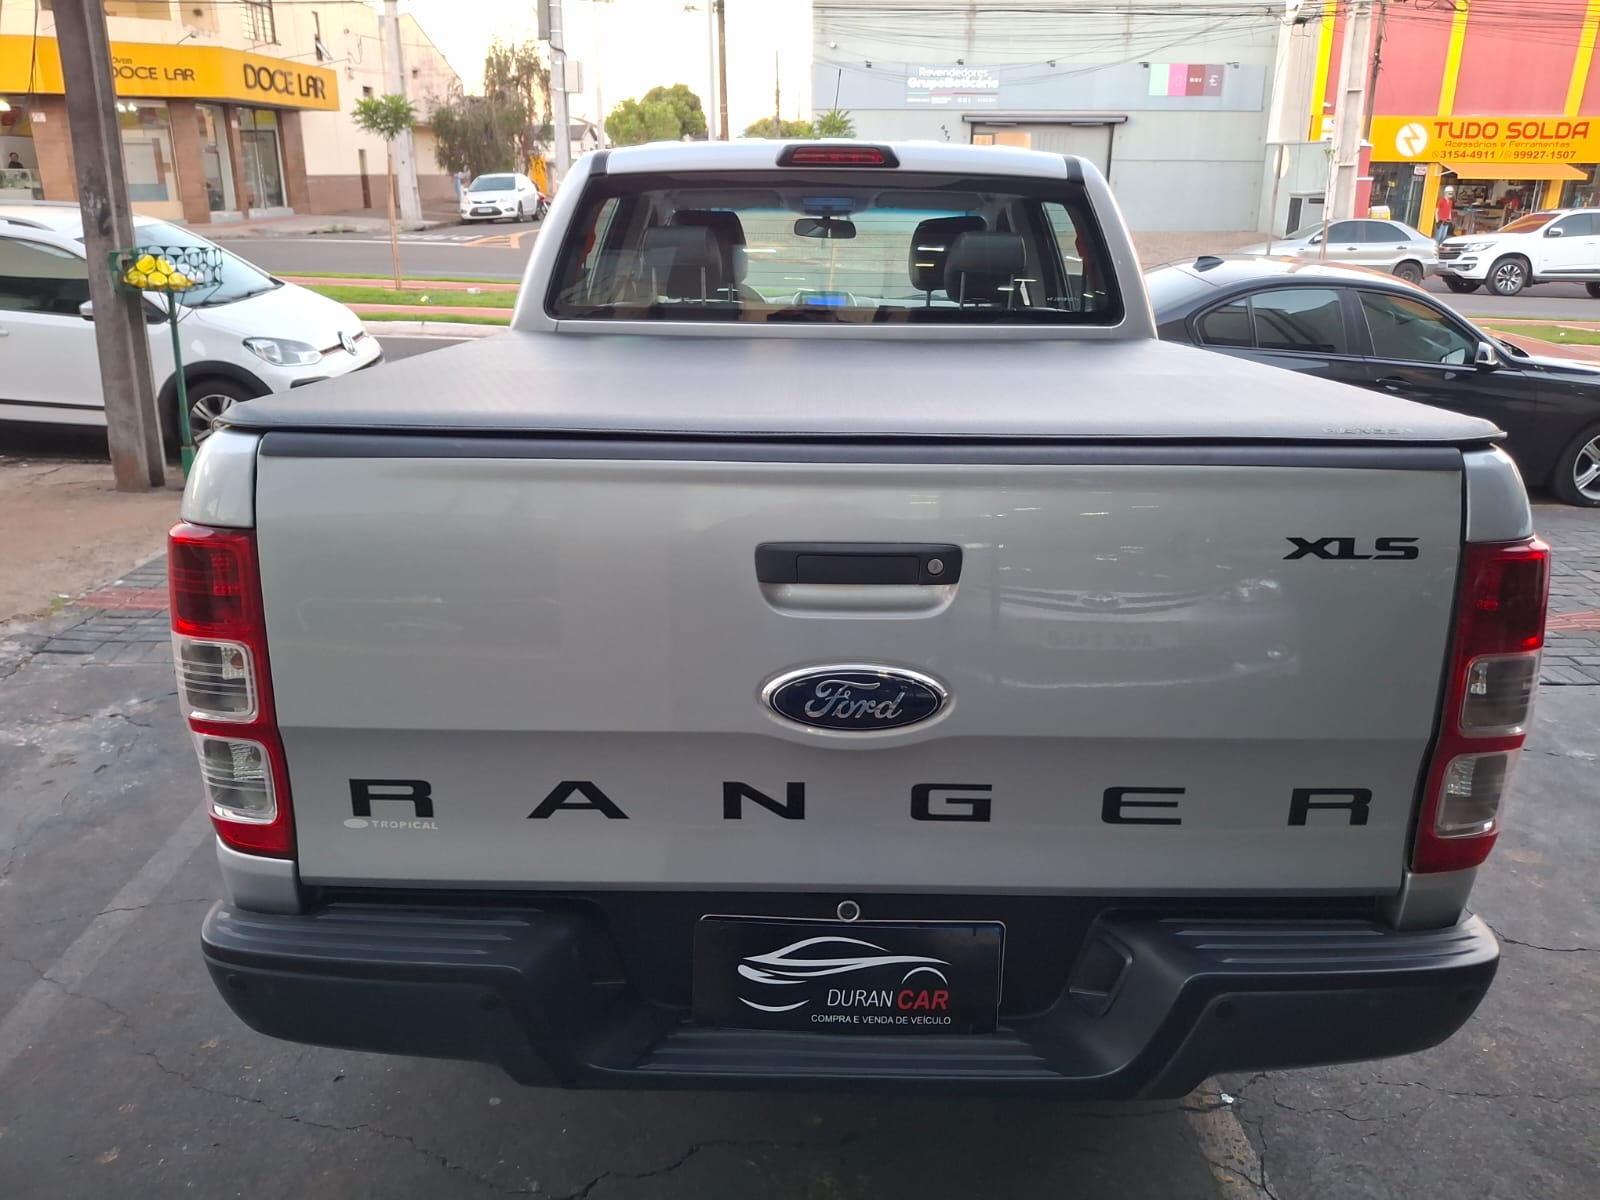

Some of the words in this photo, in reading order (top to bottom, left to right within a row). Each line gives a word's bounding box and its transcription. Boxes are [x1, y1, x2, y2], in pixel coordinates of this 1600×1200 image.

[164, 67, 196, 82] LAR
[243, 63, 295, 96] DOCE
[297, 73, 326, 100] LAR
[1434, 122, 1499, 140] TUDO
[1505, 122, 1590, 140] SOLDA
[1445, 140, 1497, 148] Acessórios
[1508, 141, 1570, 149] Ferramentas
[1440, 150, 1495, 159] 3154-4911
[1513, 151, 1577, 159] 99927-1507
[1282, 537, 1420, 560] XLS
[804, 679, 906, 720] Ford
[348, 778, 1372, 827] RANGER
[371, 819, 439, 831] TROPICAL
[826, 988, 894, 1009] DURAN
[897, 990, 949, 1011] CAR
[811, 1014, 852, 1024] COMPRA
[853, 1015, 860, 1024] E
[862, 1016, 895, 1024] VENDA
[895, 1016, 909, 1025] DE
[909, 1014, 952, 1026] VEÍCULO
